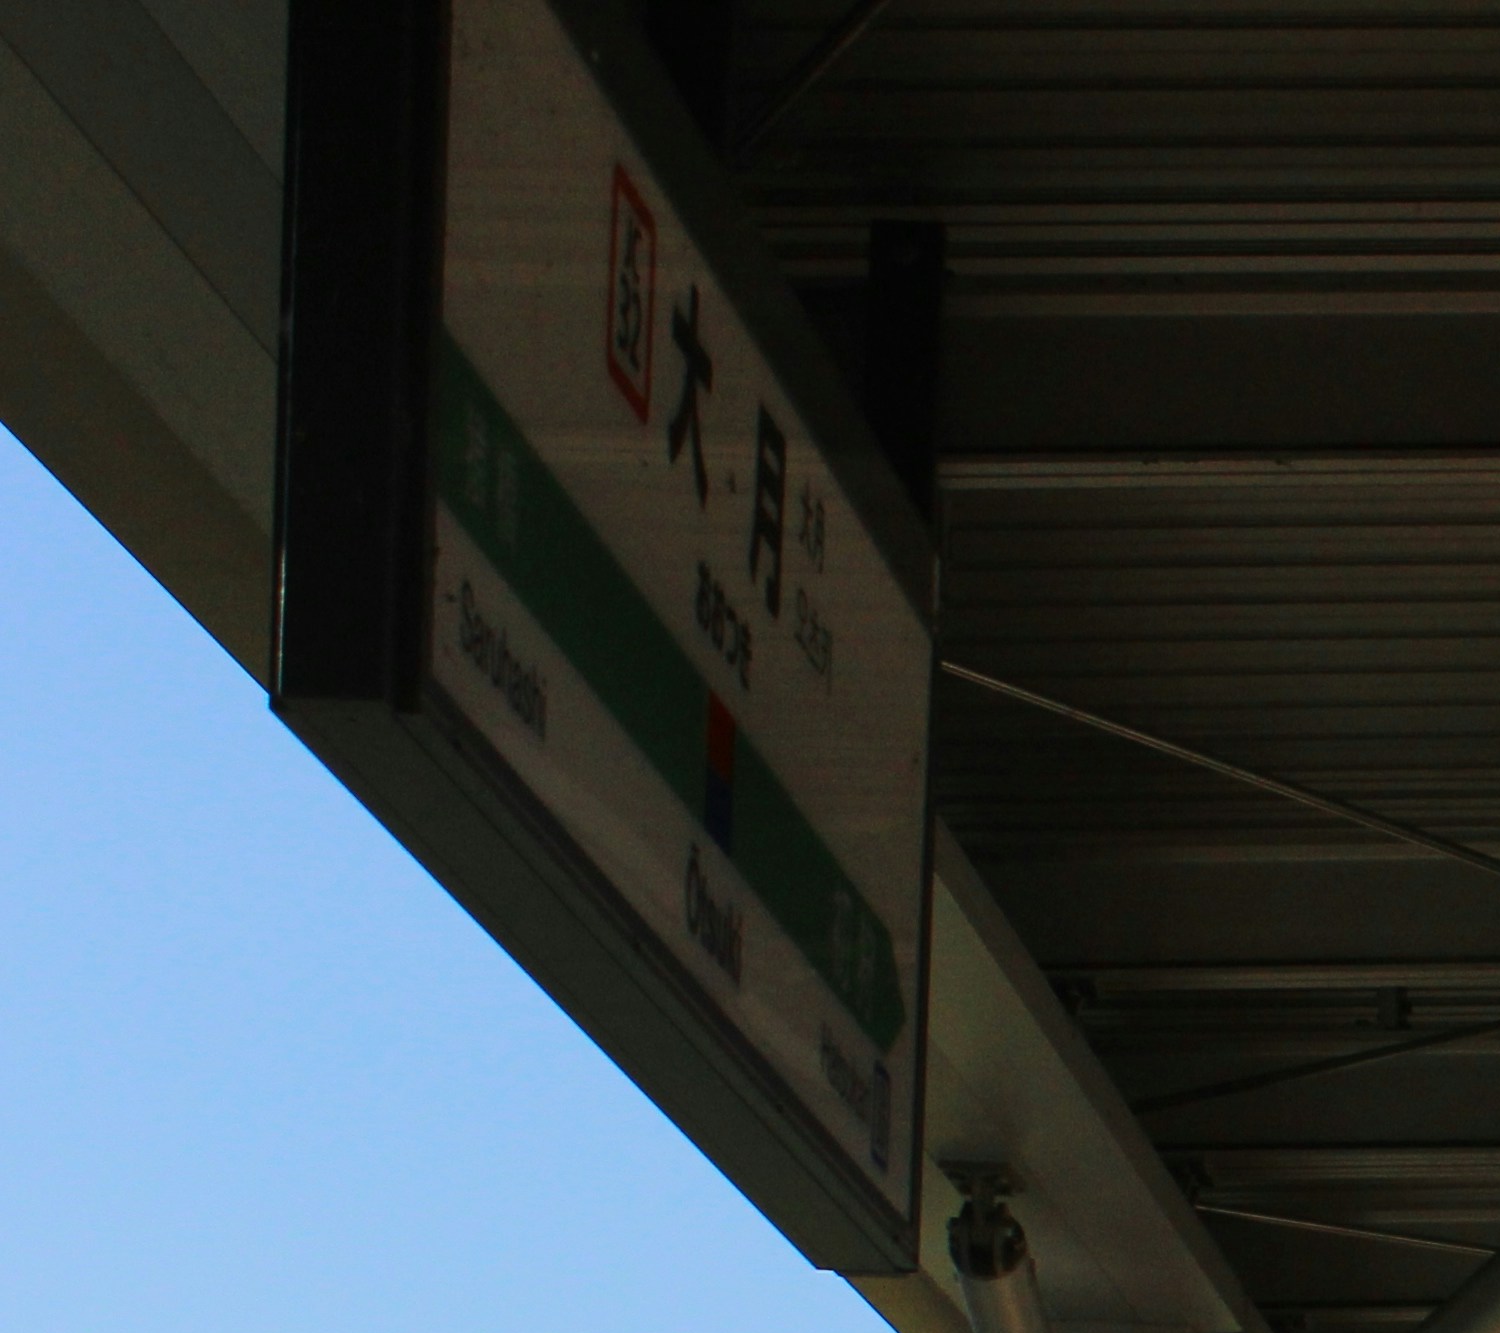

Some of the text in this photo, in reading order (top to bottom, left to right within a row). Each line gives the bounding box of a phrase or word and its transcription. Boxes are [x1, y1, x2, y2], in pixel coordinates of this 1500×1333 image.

[617, 277, 642, 373] 32
[668, 283, 787, 620] 大月
[459, 578, 547, 743] Saruhashi
[696, 560, 752, 693] おおつき
[686, 842, 743, 988] Ōtsuki
